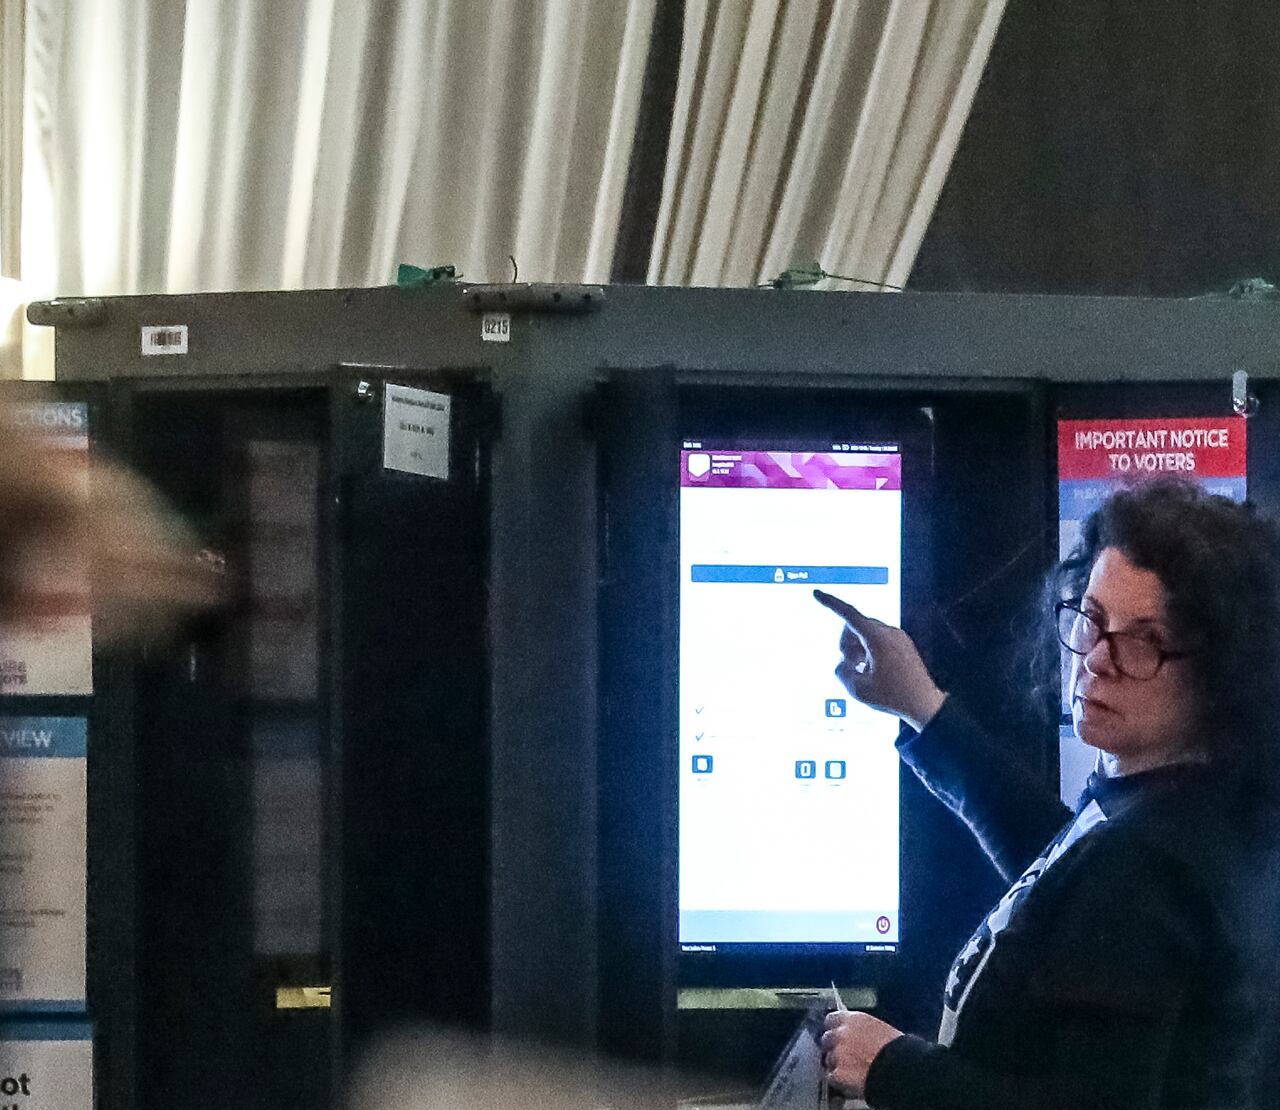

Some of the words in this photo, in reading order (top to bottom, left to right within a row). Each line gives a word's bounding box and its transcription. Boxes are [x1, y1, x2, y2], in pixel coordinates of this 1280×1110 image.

[1076, 430, 1167, 449] IMPORTANT
[1170, 429, 1228, 447] NOTICE
[1109, 453, 1130, 471] TO
[1134, 453, 1196, 471] VOTERS
